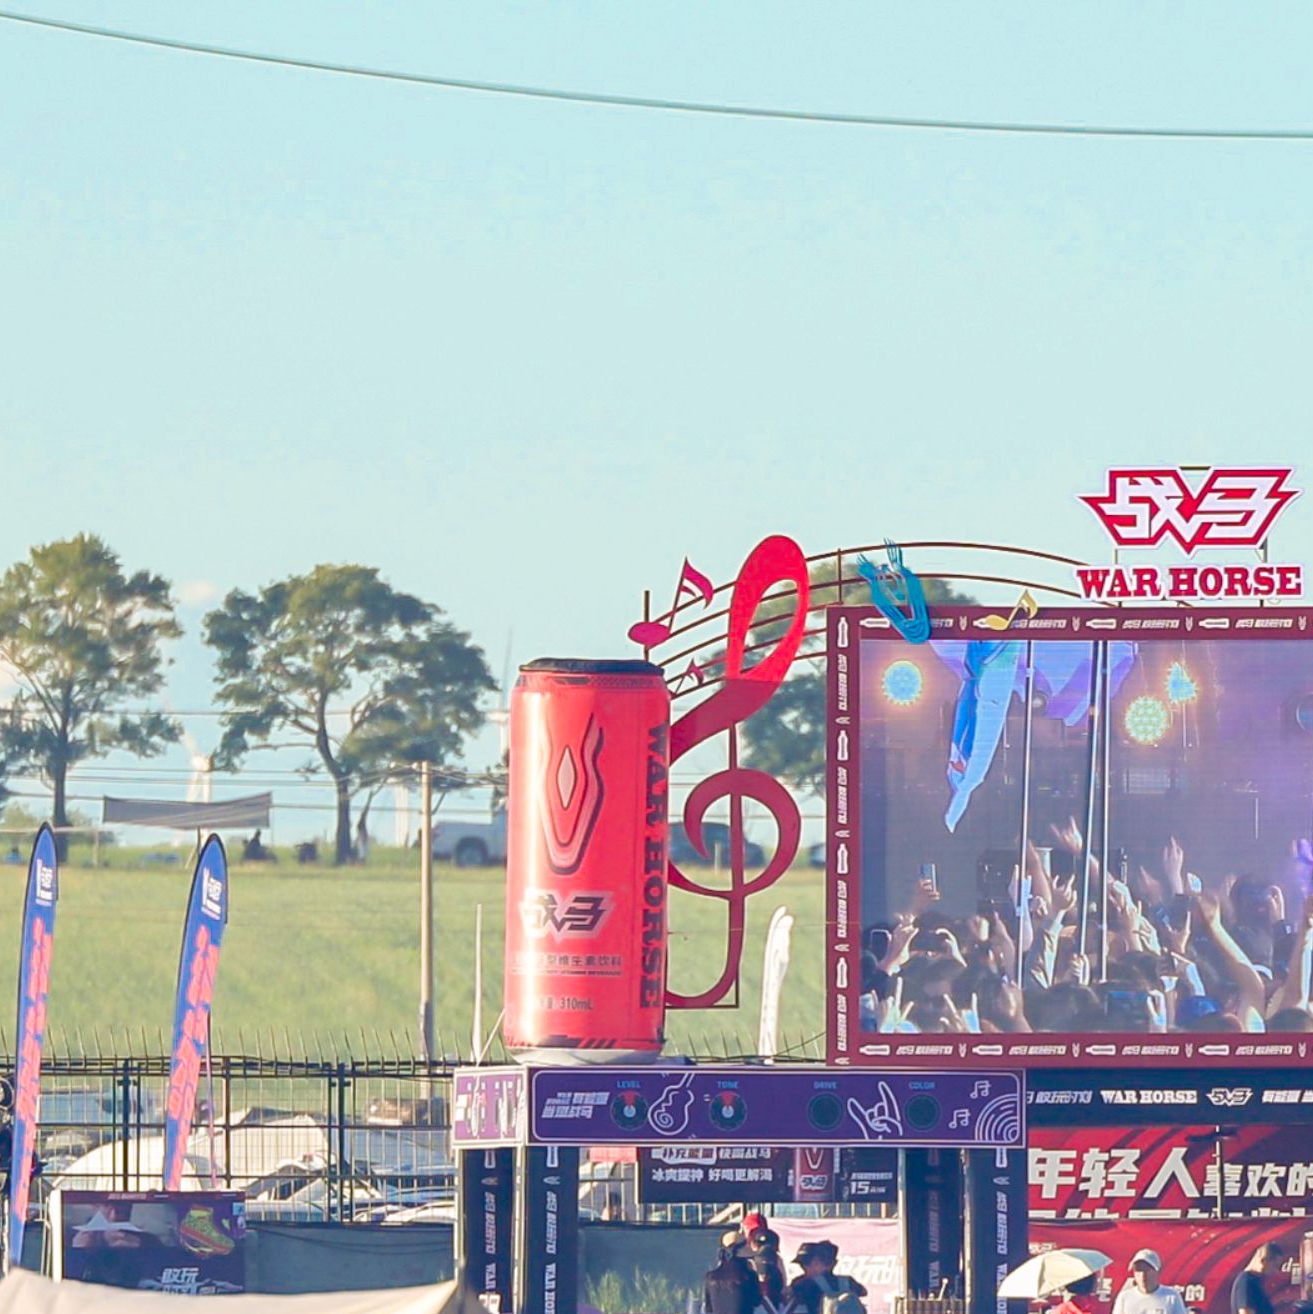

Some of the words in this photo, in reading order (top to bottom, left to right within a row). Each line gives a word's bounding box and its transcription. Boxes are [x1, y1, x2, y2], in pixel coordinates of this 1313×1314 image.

[1076, 566, 1162, 599] WAR
[1169, 566, 1302, 598] HORSE
[645, 721, 668, 829] WAR
[639, 833, 665, 1008] HORSE
[559, 995, 594, 1011] 310mL
[616, 1080, 641, 1089] LEVEL
[717, 1081, 739, 1089] TONE
[908, 1082, 935, 1090] COLOR
[1100, 1089, 1138, 1104] WAR
[1139, 1089, 1198, 1104] HORSE
[851, 1181, 870, 1194] 15
[485, 1262, 497, 1290] WAR
[545, 1262, 557, 1290] WAR
